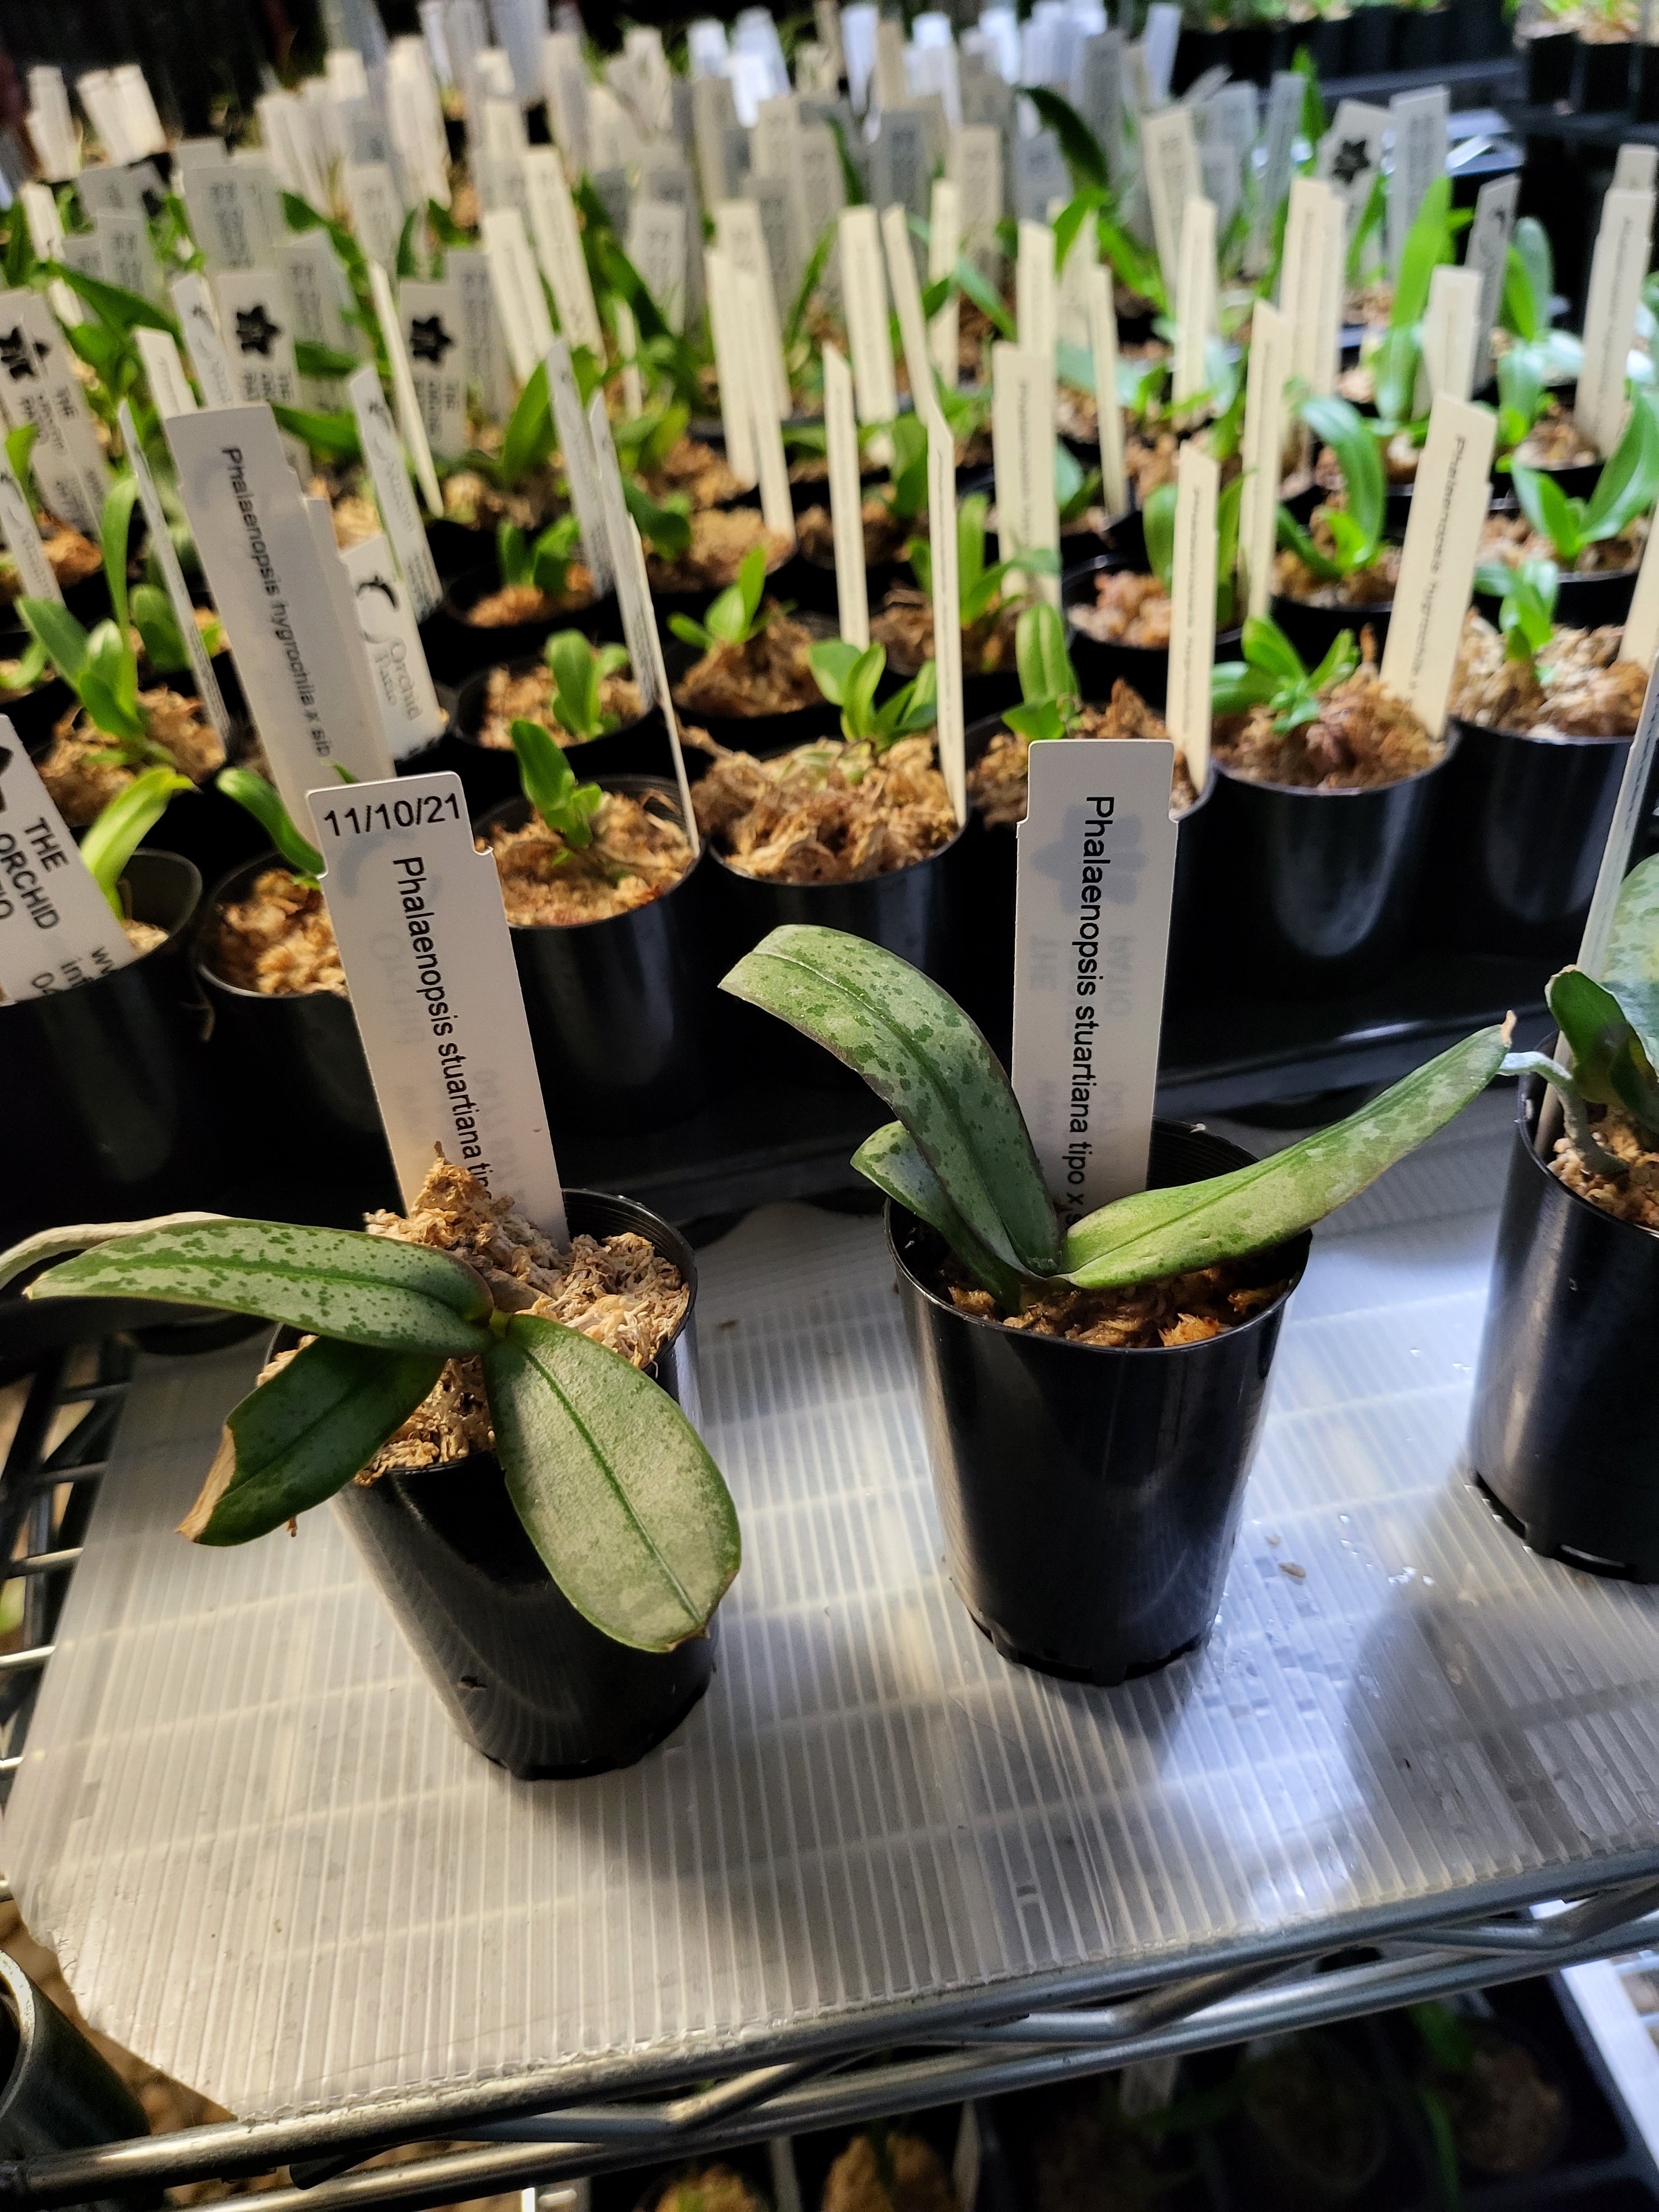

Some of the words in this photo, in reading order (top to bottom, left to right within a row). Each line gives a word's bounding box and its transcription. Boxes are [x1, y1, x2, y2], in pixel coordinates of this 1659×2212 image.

[222, 445, 281, 597] Phalaenopsis
[25, 817, 70, 873] THE
[324, 793, 460, 836] 11/10/21
[0, 833, 60, 930] ORCHID
[1072, 797, 1114, 996] Phalaenopsis
[393, 857, 458, 1036] Phalaenopsis
[438, 1042, 482, 1159] stuartiana
[1069, 1005, 1099, 1133] stuartiana
[1062, 1141, 1092, 1185] tipo
[1067, 1192, 1084, 1206] x
